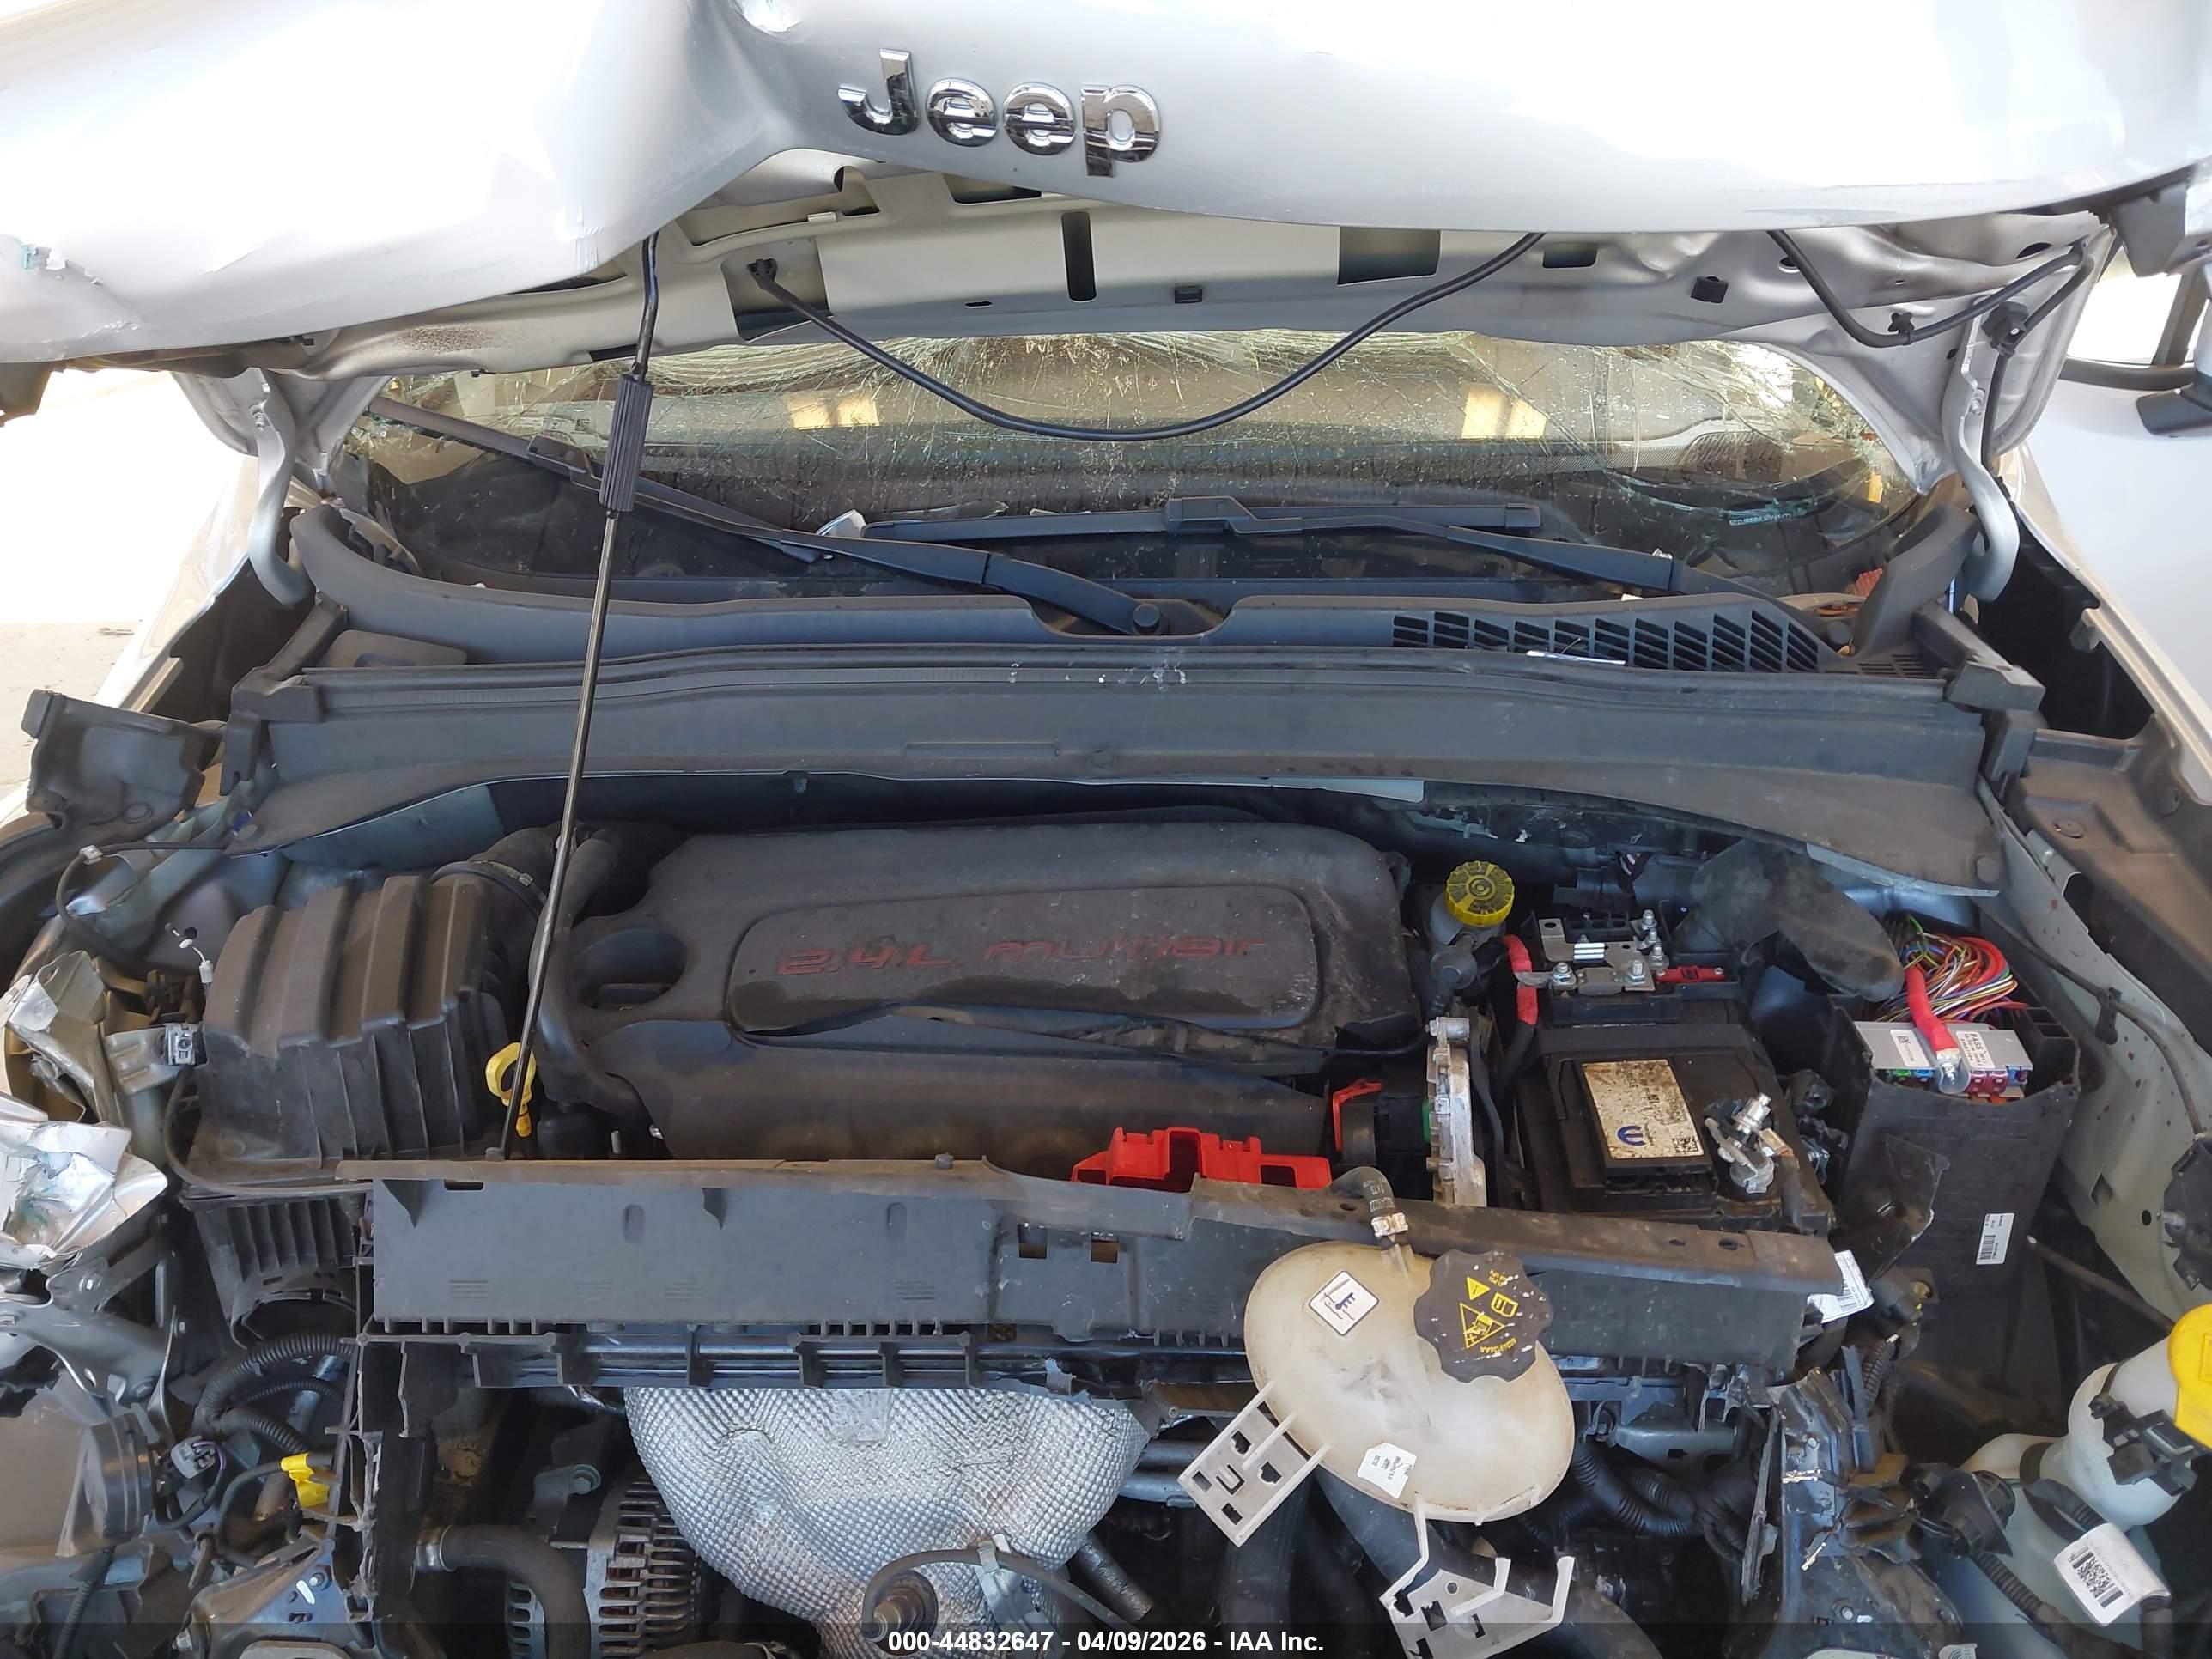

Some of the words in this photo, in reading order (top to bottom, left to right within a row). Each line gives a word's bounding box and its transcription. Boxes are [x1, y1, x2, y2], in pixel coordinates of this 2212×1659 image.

[837, 48, 1162, 178] Jeep
[777, 941, 963, 976] 2.4L
[1969, 1033, 1984, 1051] PASS
